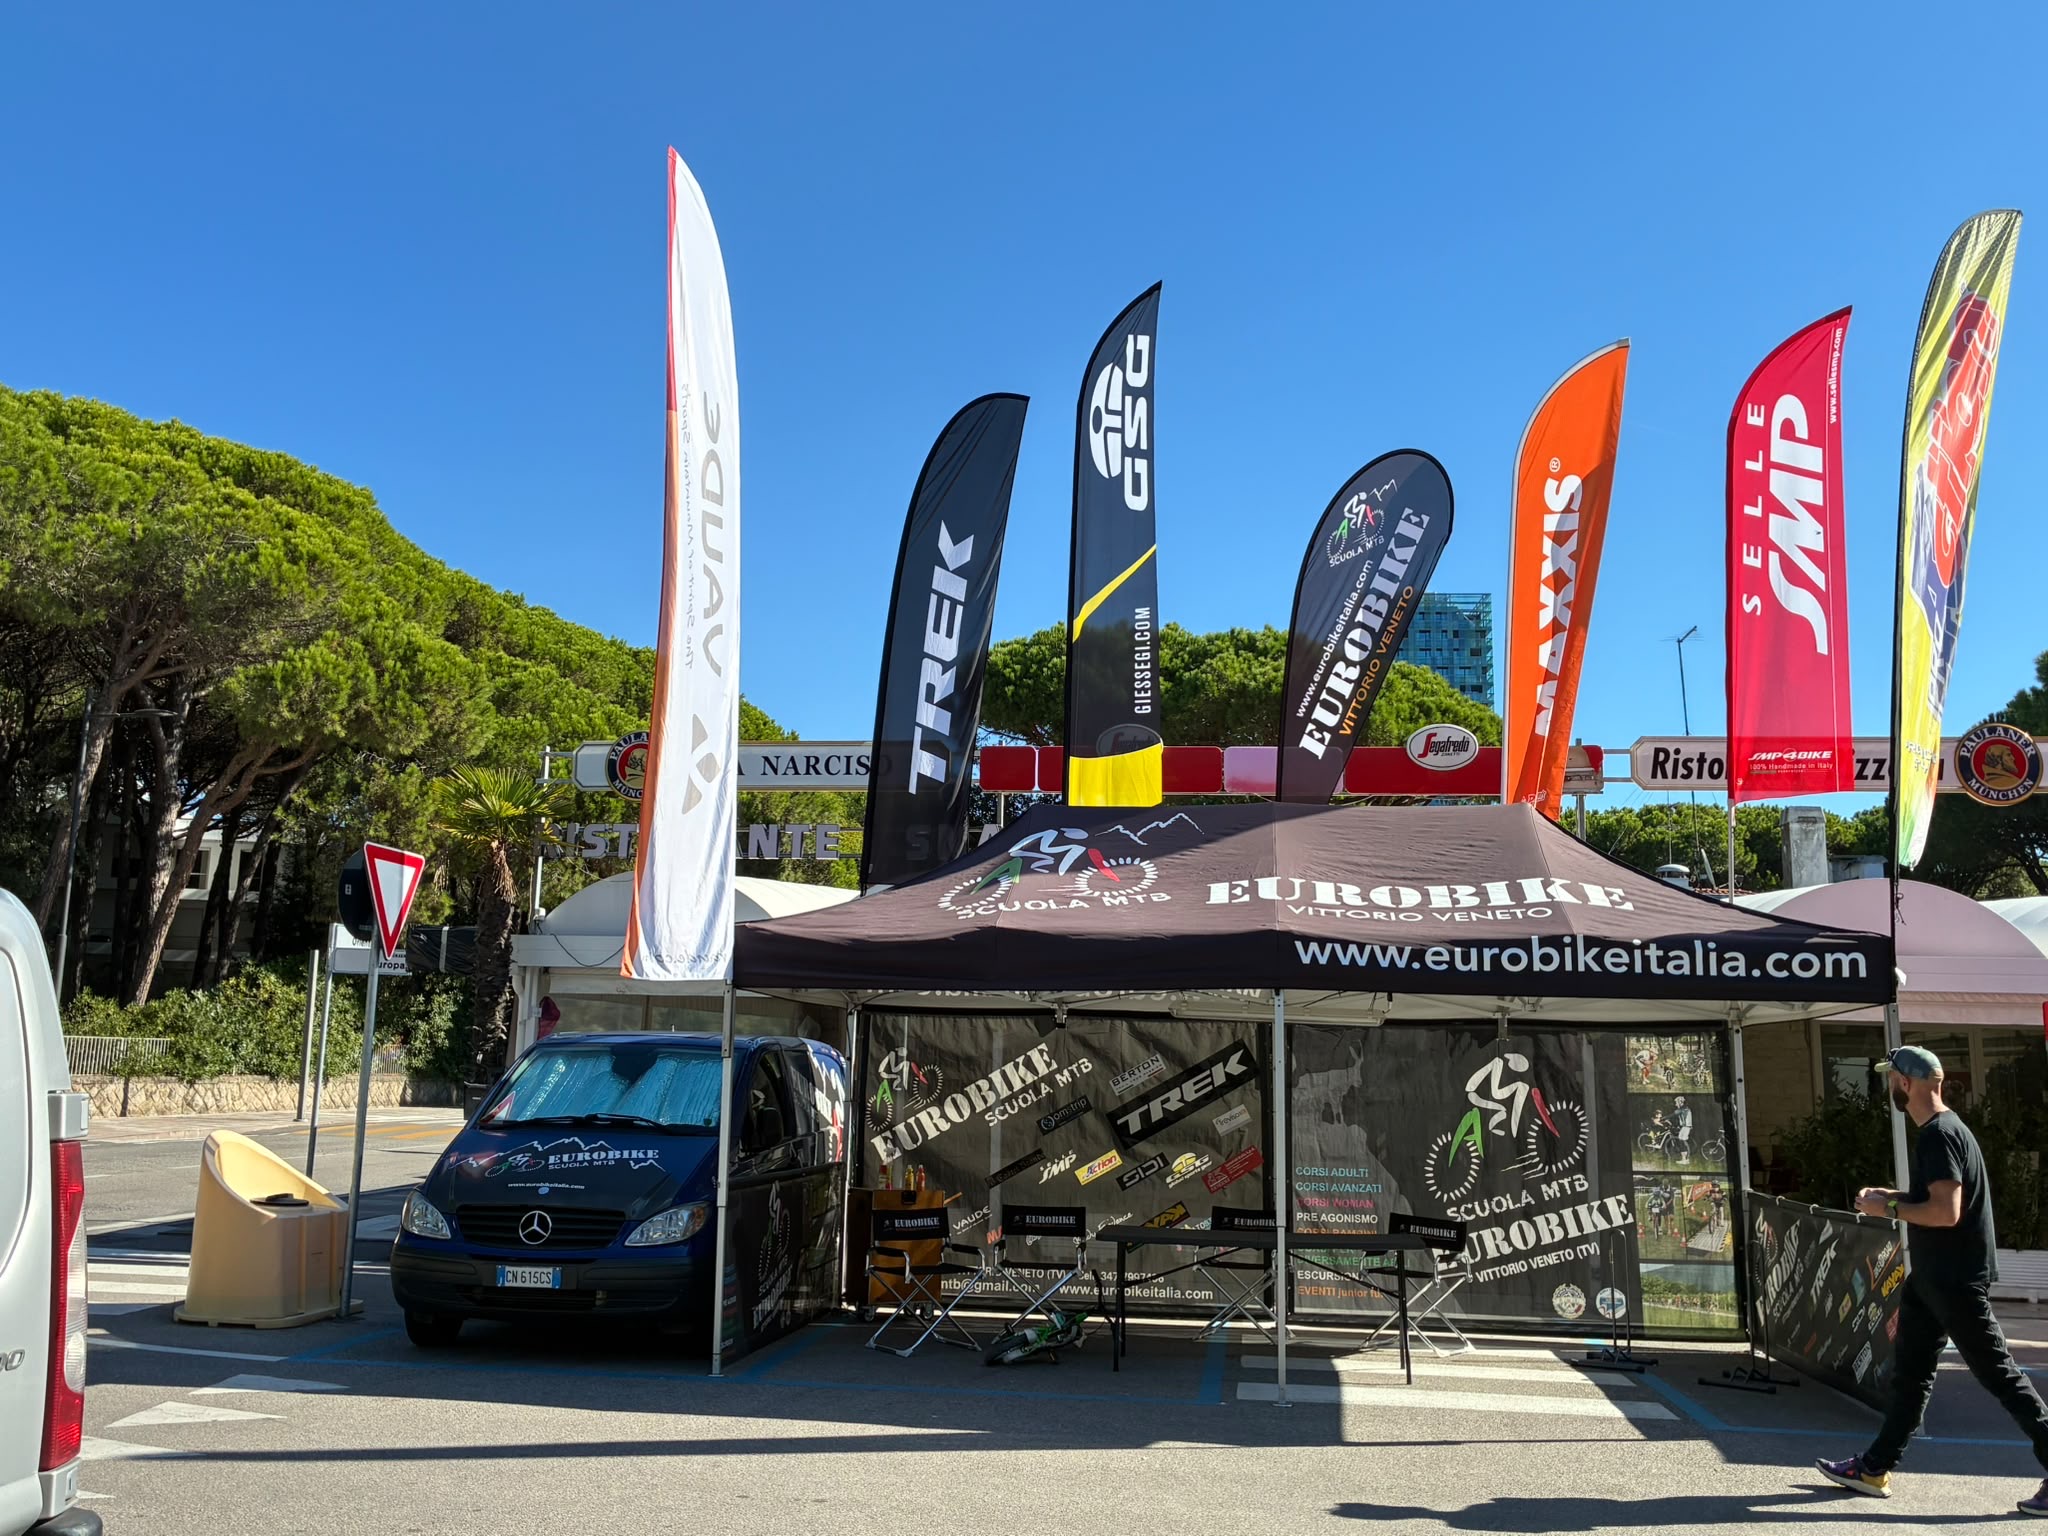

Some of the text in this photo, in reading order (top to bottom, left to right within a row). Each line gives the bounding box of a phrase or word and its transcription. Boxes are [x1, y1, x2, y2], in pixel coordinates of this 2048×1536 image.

[1829, 327, 1844, 424] www.sellesmp.com
[1123, 333, 1151, 511] GSG
[1742, 403, 1765, 616] SELLE
[1767, 393, 1828, 656] SMP
[1328, 535, 1385, 568] SCUOLA MTB
[1535, 472, 1583, 738] MAXXIS
[1296, 559, 1374, 718] www.eurobikeitalia.com
[1299, 507, 1431, 760] EUROBIKE
[908, 519, 975, 795] TREK
[1134, 606, 1151, 714] GIESSEGI.COM
[1339, 585, 1414, 736] VITTORIO VENETO
[610, 732, 649, 761] PAULA
[1417, 732, 1470, 759] Segafredo
[1748, 748, 1833, 761] SMP4BIKE
[1959, 727, 2037, 759] PAULANER
[761, 754, 880, 777] NARCIS
[1651, 747, 1727, 780] Risto
[957, 892, 1172, 920] SCUOLA MTB
[1205, 876, 1635, 911] EUROBIKE
[1287, 904, 1553, 922] VITTORIO VENETO
[378, 960, 405, 971] uropa
[1294, 935, 1868, 979] www.eurobikeitalia.com
[1111, 1054, 1160, 1087] BERTON
[870, 1042, 1058, 1164] EUROBIKE
[984, 1083, 1053, 1127] SCUOLA
[1055, 1057, 1093, 1088] MTB
[1117, 1049, 1248, 1135] TREK
[548, 1149, 659, 1165] EUROBIKE
[548, 1161, 590, 1170] SCUOLA
[1122, 1159, 1165, 1186] SIDI
[1165, 1153, 1211, 1183] GSG
[1296, 1166, 1369, 1178] CORSI ADULTI
[1296, 1182, 1381, 1193] CORSI AVANZATI
[1297, 1197, 1329, 1207] CORSI
[1446, 1173, 1590, 1223] SCUOLA MTB
[895, 1216, 940, 1229] EUROBIKE
[952, 1205, 991, 1231] VAUDE
[1026, 1215, 1076, 1225] EUROBIKE
[1234, 1217, 1276, 1228] EUROBIK
[1296, 1212, 1378, 1224] PRE AGONISMO
[1409, 1225, 1457, 1239] EUROBIKE
[1475, 1241, 1601, 1283] VITTORIO VENETO (TV)
[1810, 1238, 1840, 1305] TREK
[505, 1271, 551, 1285] CN 615CS
[1298, 1286, 1336, 1297] EVENTI
[1338, 1287, 1368, 1299] junior
